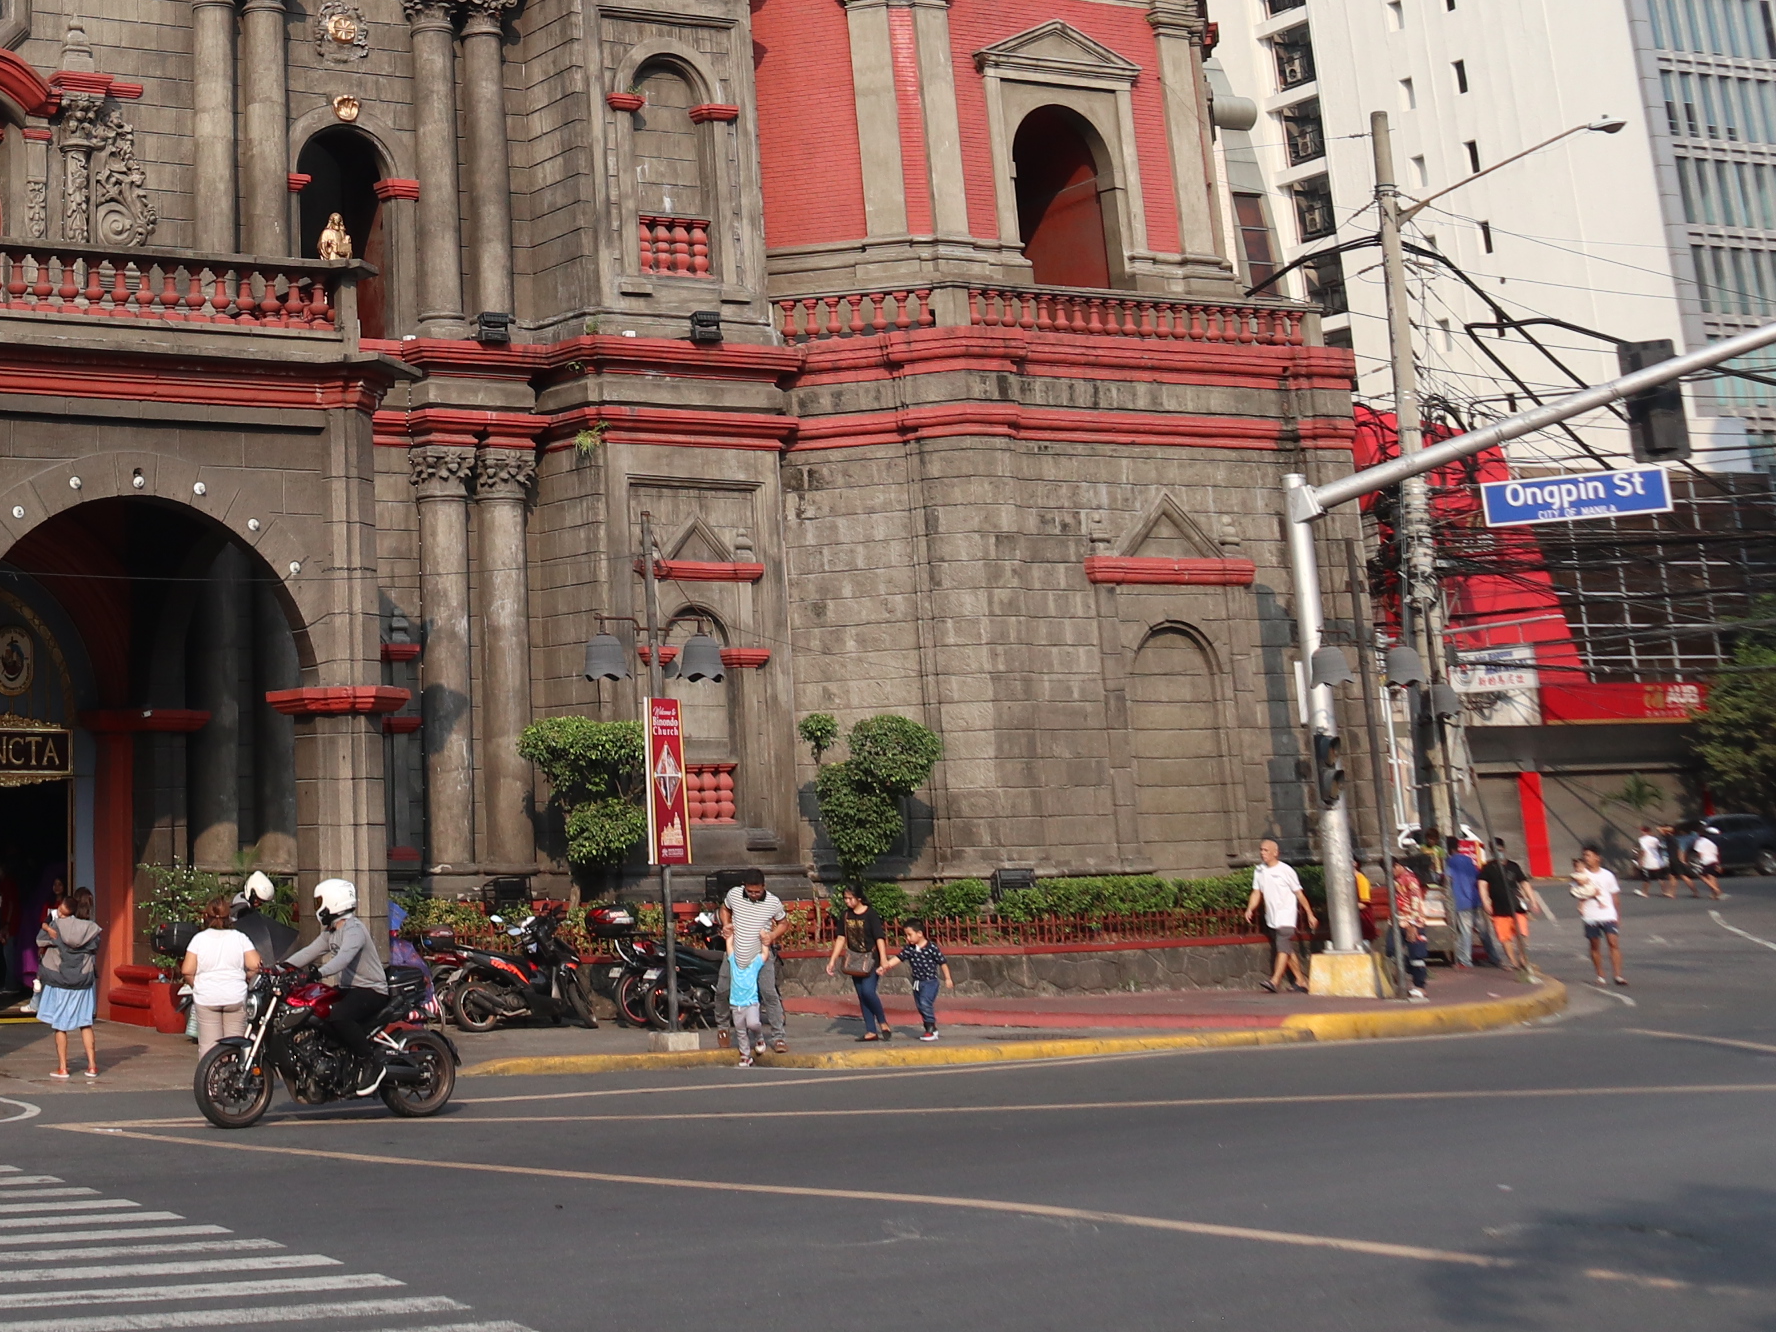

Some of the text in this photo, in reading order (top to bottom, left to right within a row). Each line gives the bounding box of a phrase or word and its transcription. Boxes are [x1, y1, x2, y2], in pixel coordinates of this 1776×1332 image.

[1505, 472, 1646, 509] Ongpin St
[1538, 504, 1618, 520] CITY OF MANILA
[652, 716, 678, 726] Binondo
[653, 726, 679, 735] Church
